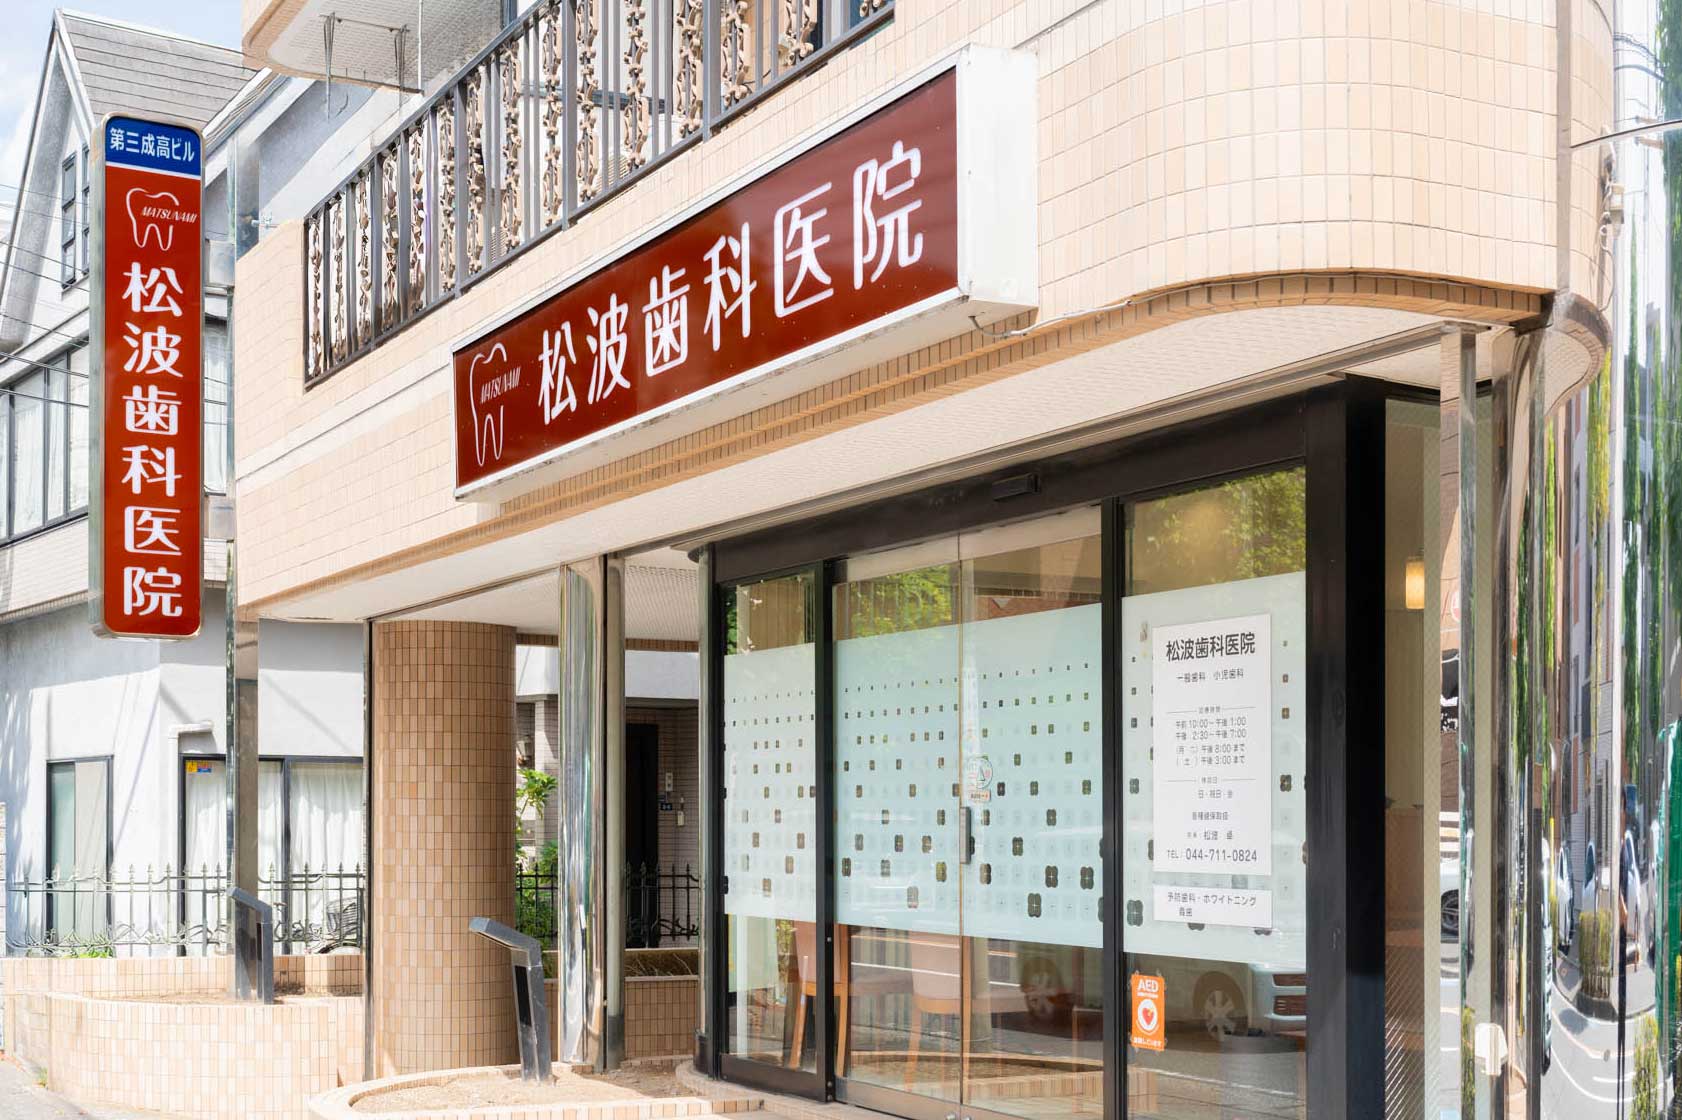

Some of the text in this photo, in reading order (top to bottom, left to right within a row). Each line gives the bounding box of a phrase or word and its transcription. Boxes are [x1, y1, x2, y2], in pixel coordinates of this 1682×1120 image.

[109, 127, 195, 162] 第三成高ビル
[534, 138, 924, 425] 松波歯科医院
[121, 261, 184, 618] 松波歯科医院
[1165, 631, 1256, 662] 松波歯科医院
[1185, 848, 1257, 862] 044-711-0824
[1137, 979, 1159, 992] AED
